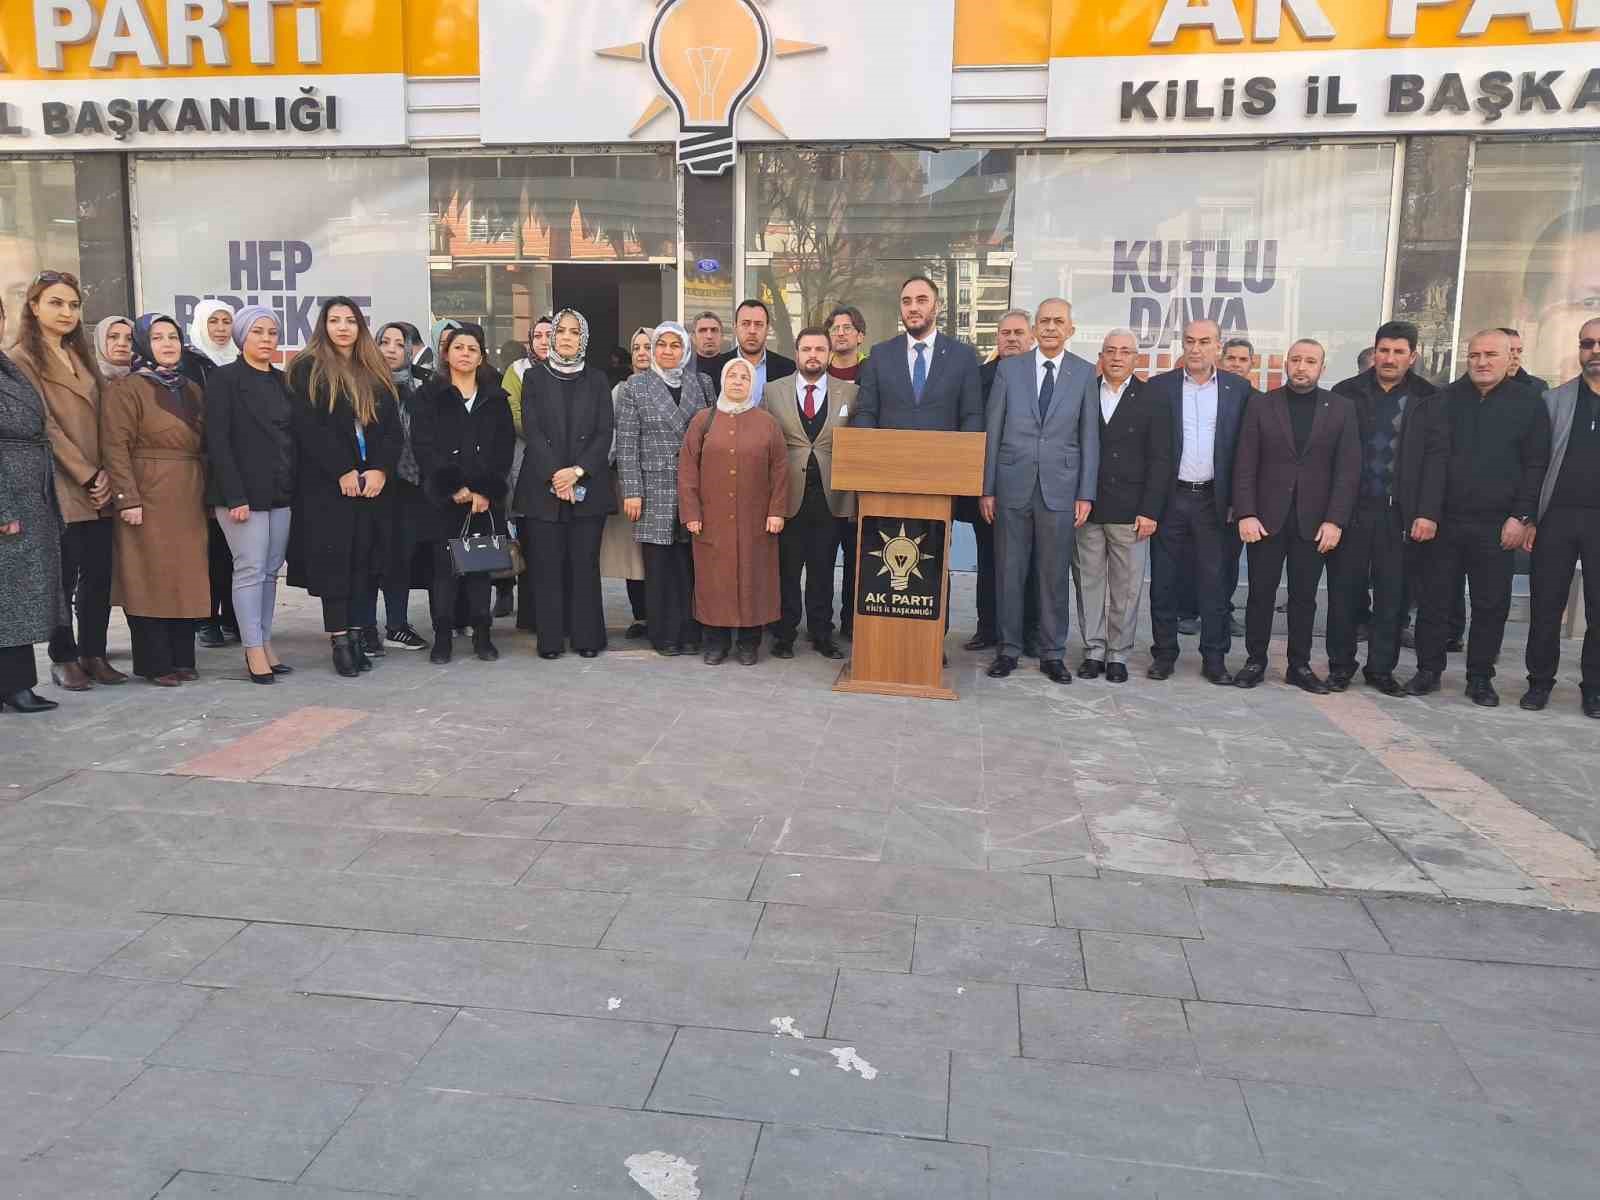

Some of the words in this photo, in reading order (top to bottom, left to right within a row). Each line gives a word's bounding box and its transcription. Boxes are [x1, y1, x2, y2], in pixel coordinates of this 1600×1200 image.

[42, 86, 337, 141] BAŞKANLIĞI
[228, 240, 312, 291] HEP
[1112, 239, 1278, 294] KUTLU
[865, 592, 886, 604] AK
